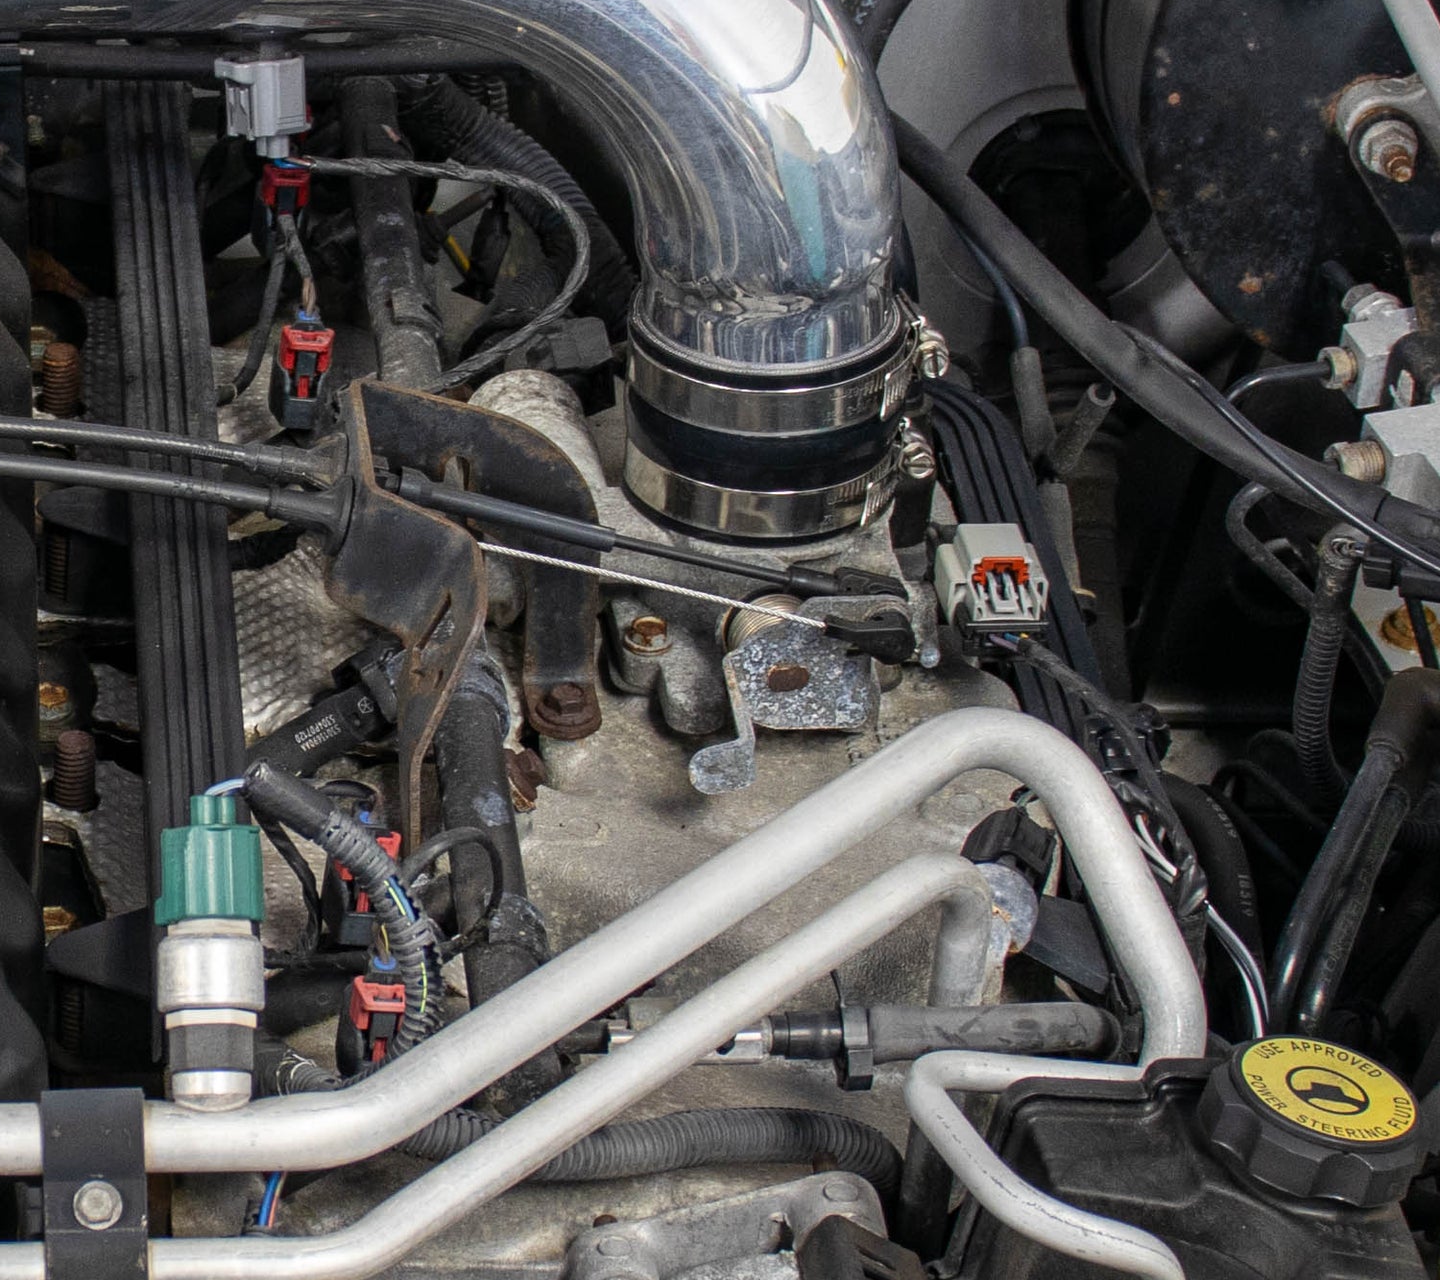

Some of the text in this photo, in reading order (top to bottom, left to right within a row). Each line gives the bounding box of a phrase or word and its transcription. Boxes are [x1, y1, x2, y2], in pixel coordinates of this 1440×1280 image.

[1254, 1041, 1382, 1079] USE APPROVED
[1247, 1073, 1410, 1139] POWER STEERING FLUID
